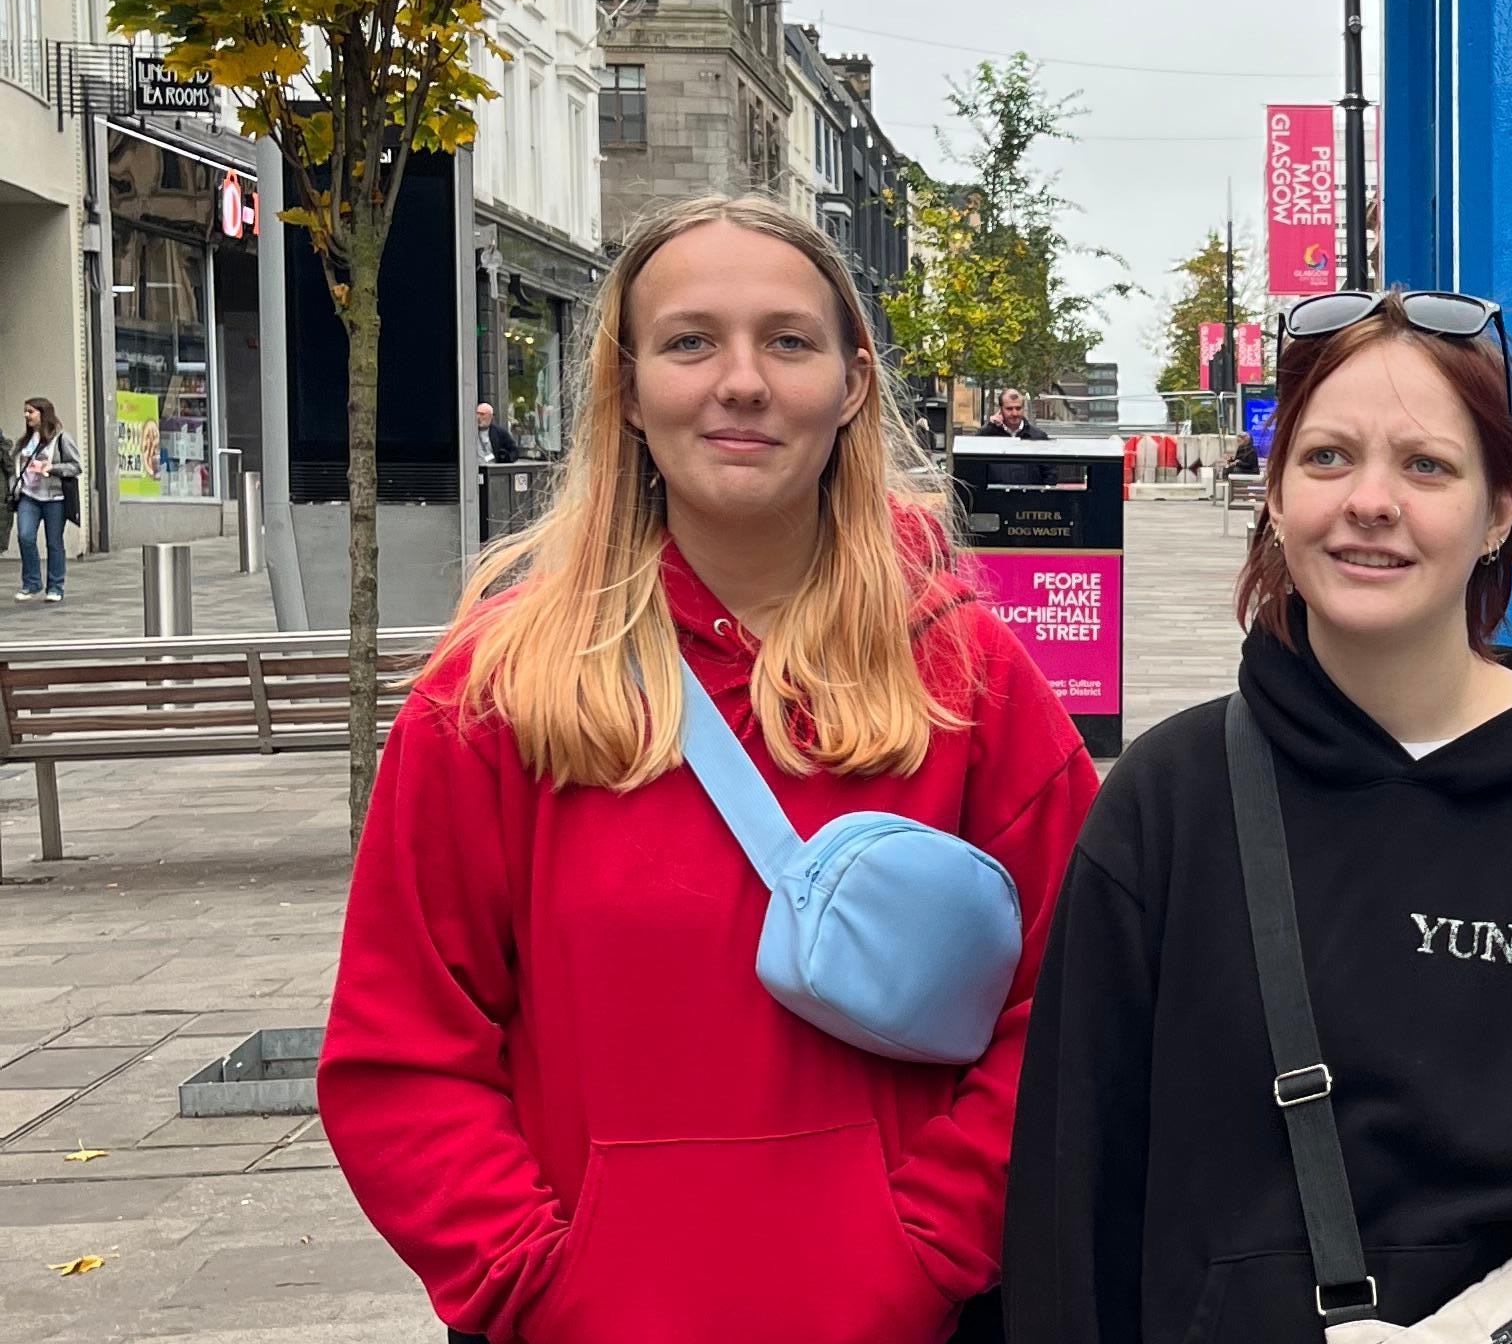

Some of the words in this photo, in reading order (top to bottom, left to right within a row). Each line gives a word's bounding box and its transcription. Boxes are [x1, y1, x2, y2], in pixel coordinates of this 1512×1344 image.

[139, 83, 163, 106] TEA
[165, 86, 209, 106] ROOMS
[1271, 113, 1292, 225] GLASGOW
[1292, 163, 1312, 225] MAKE
[1312, 146, 1332, 225] PEOPLE
[1015, 511, 1053, 521] LITTER
[1053, 511, 1062, 521] &
[1007, 527, 1032, 536] DOG
[1032, 527, 1072, 537] WASTE
[1033, 572, 1102, 590] PEOPLE
[1048, 590, 1102, 607] MAKE
[990, 607, 1101, 624] AUCHIEHALL
[1035, 624, 1101, 641] STREET
[1068, 679, 1102, 688] Culture
[1069, 688, 1102, 697] District
